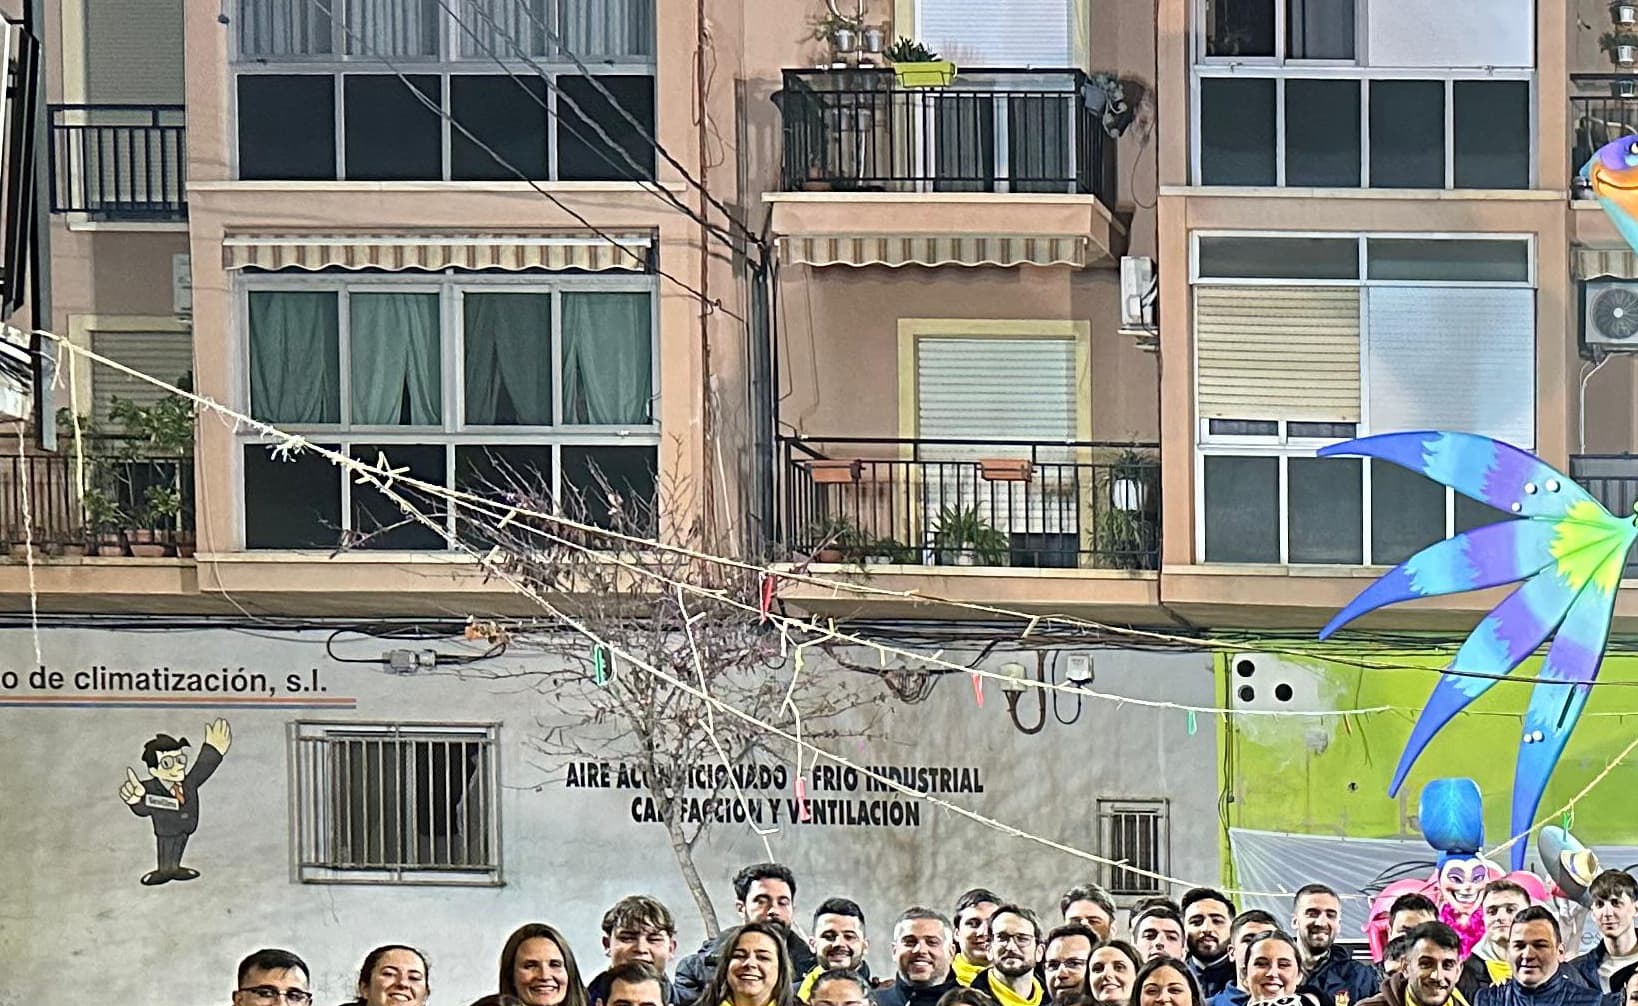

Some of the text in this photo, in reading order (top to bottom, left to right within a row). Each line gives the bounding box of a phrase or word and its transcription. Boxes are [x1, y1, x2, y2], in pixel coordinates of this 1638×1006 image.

[29, 665, 64, 689] de
[74, 666, 276, 697] climatización,
[286, 669, 327, 692] s.l.
[566, 762, 610, 788] AIRE
[813, 765, 858, 792] FRIO
[866, 766, 984, 793] INDUSTRIAL
[770, 798, 782, 824] Y
